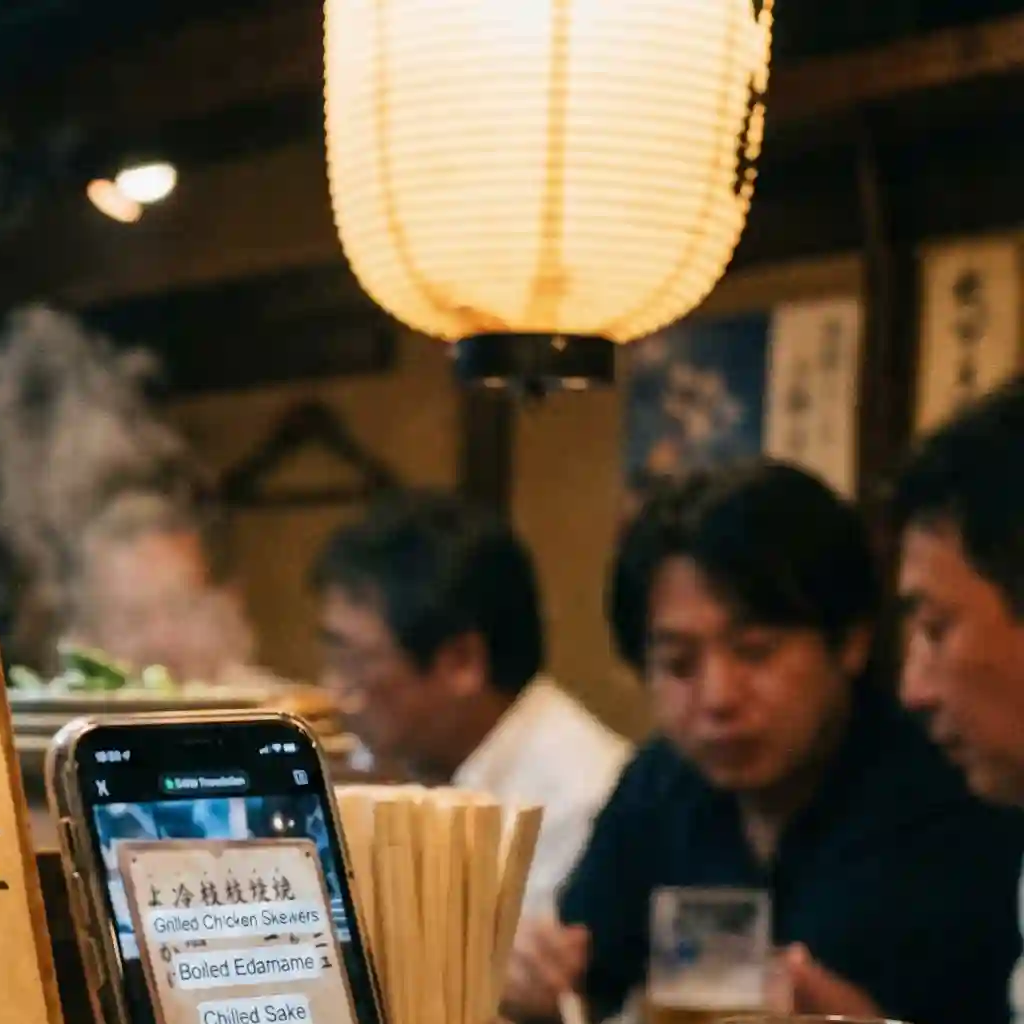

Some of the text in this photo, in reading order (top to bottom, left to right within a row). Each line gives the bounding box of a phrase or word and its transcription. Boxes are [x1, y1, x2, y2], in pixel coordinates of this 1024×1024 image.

[153, 909, 320, 934] Grilled Chicken Skewers
[178, 959, 230, 981] Boiled
[234, 956, 315, 977] Edamame
[264, 1003, 307, 1022] Sake
